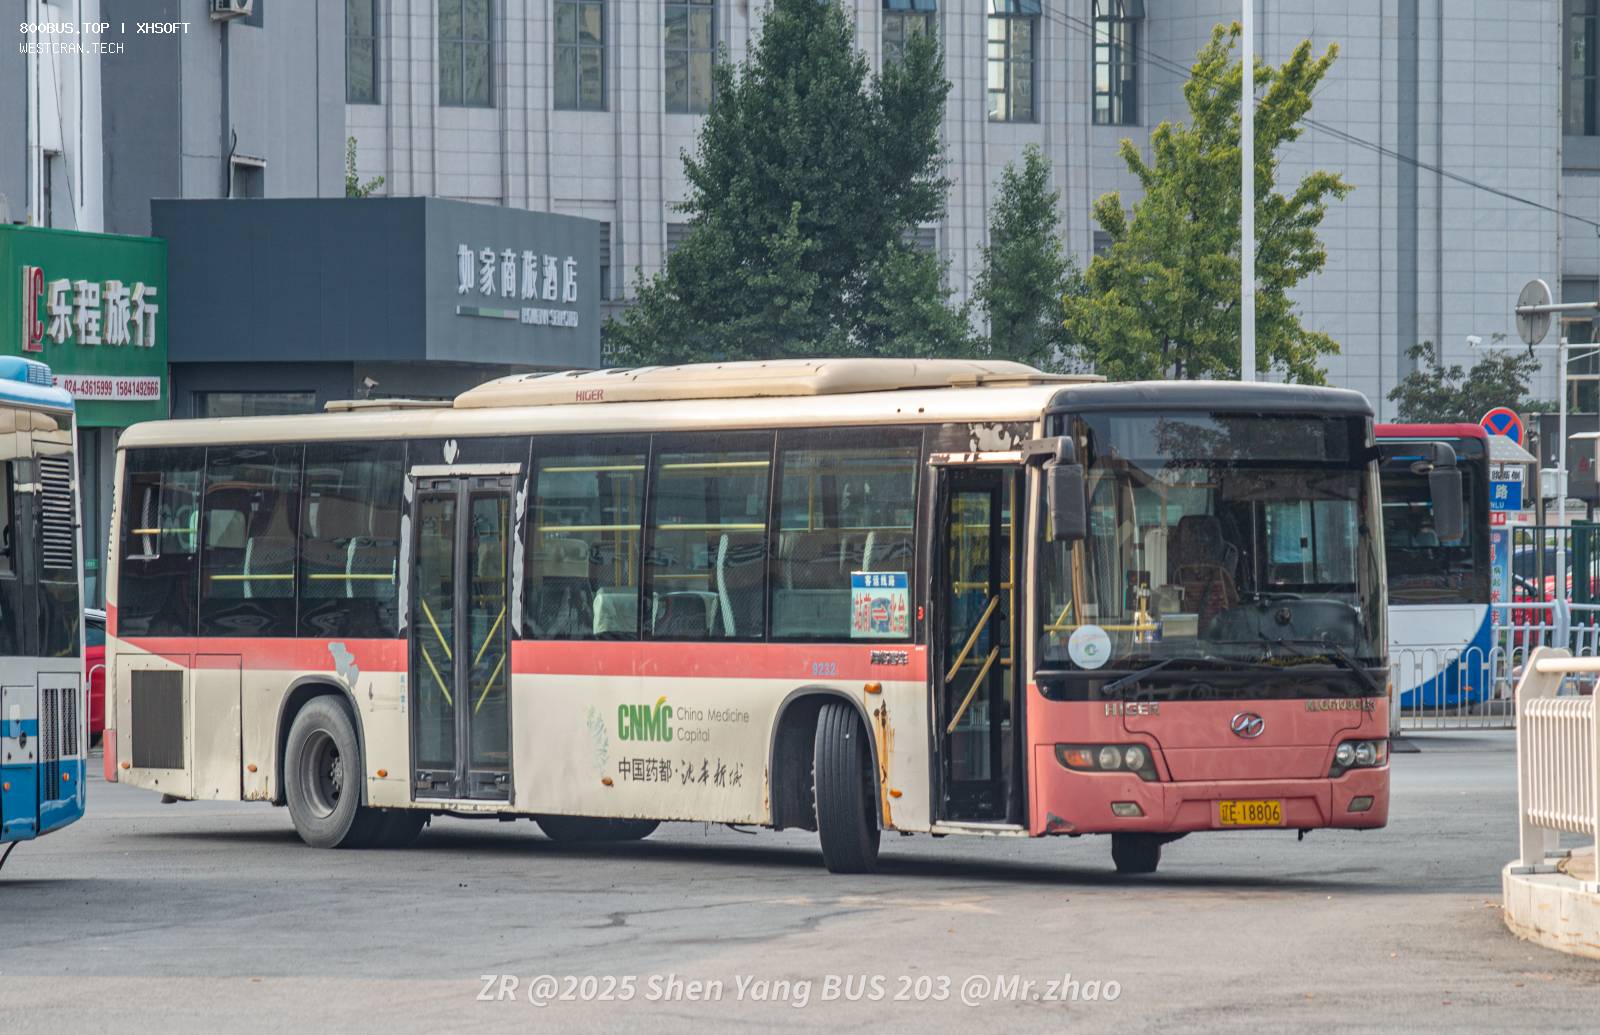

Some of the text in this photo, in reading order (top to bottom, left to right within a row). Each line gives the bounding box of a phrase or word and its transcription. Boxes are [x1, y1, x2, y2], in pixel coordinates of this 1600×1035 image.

[457, 243, 578, 303] 如家商旅酒店
[47, 278, 159, 348] 乐程旅行
[64, 380, 113, 396] 024-43615999
[116, 381, 159, 396] 15841492666
[575, 388, 605, 402] HIGER
[677, 707, 750, 723] China Medicine
[1105, 702, 1160, 717] HIGER
[617, 697, 673, 742] CNMC
[677, 728, 711, 744] Capital
